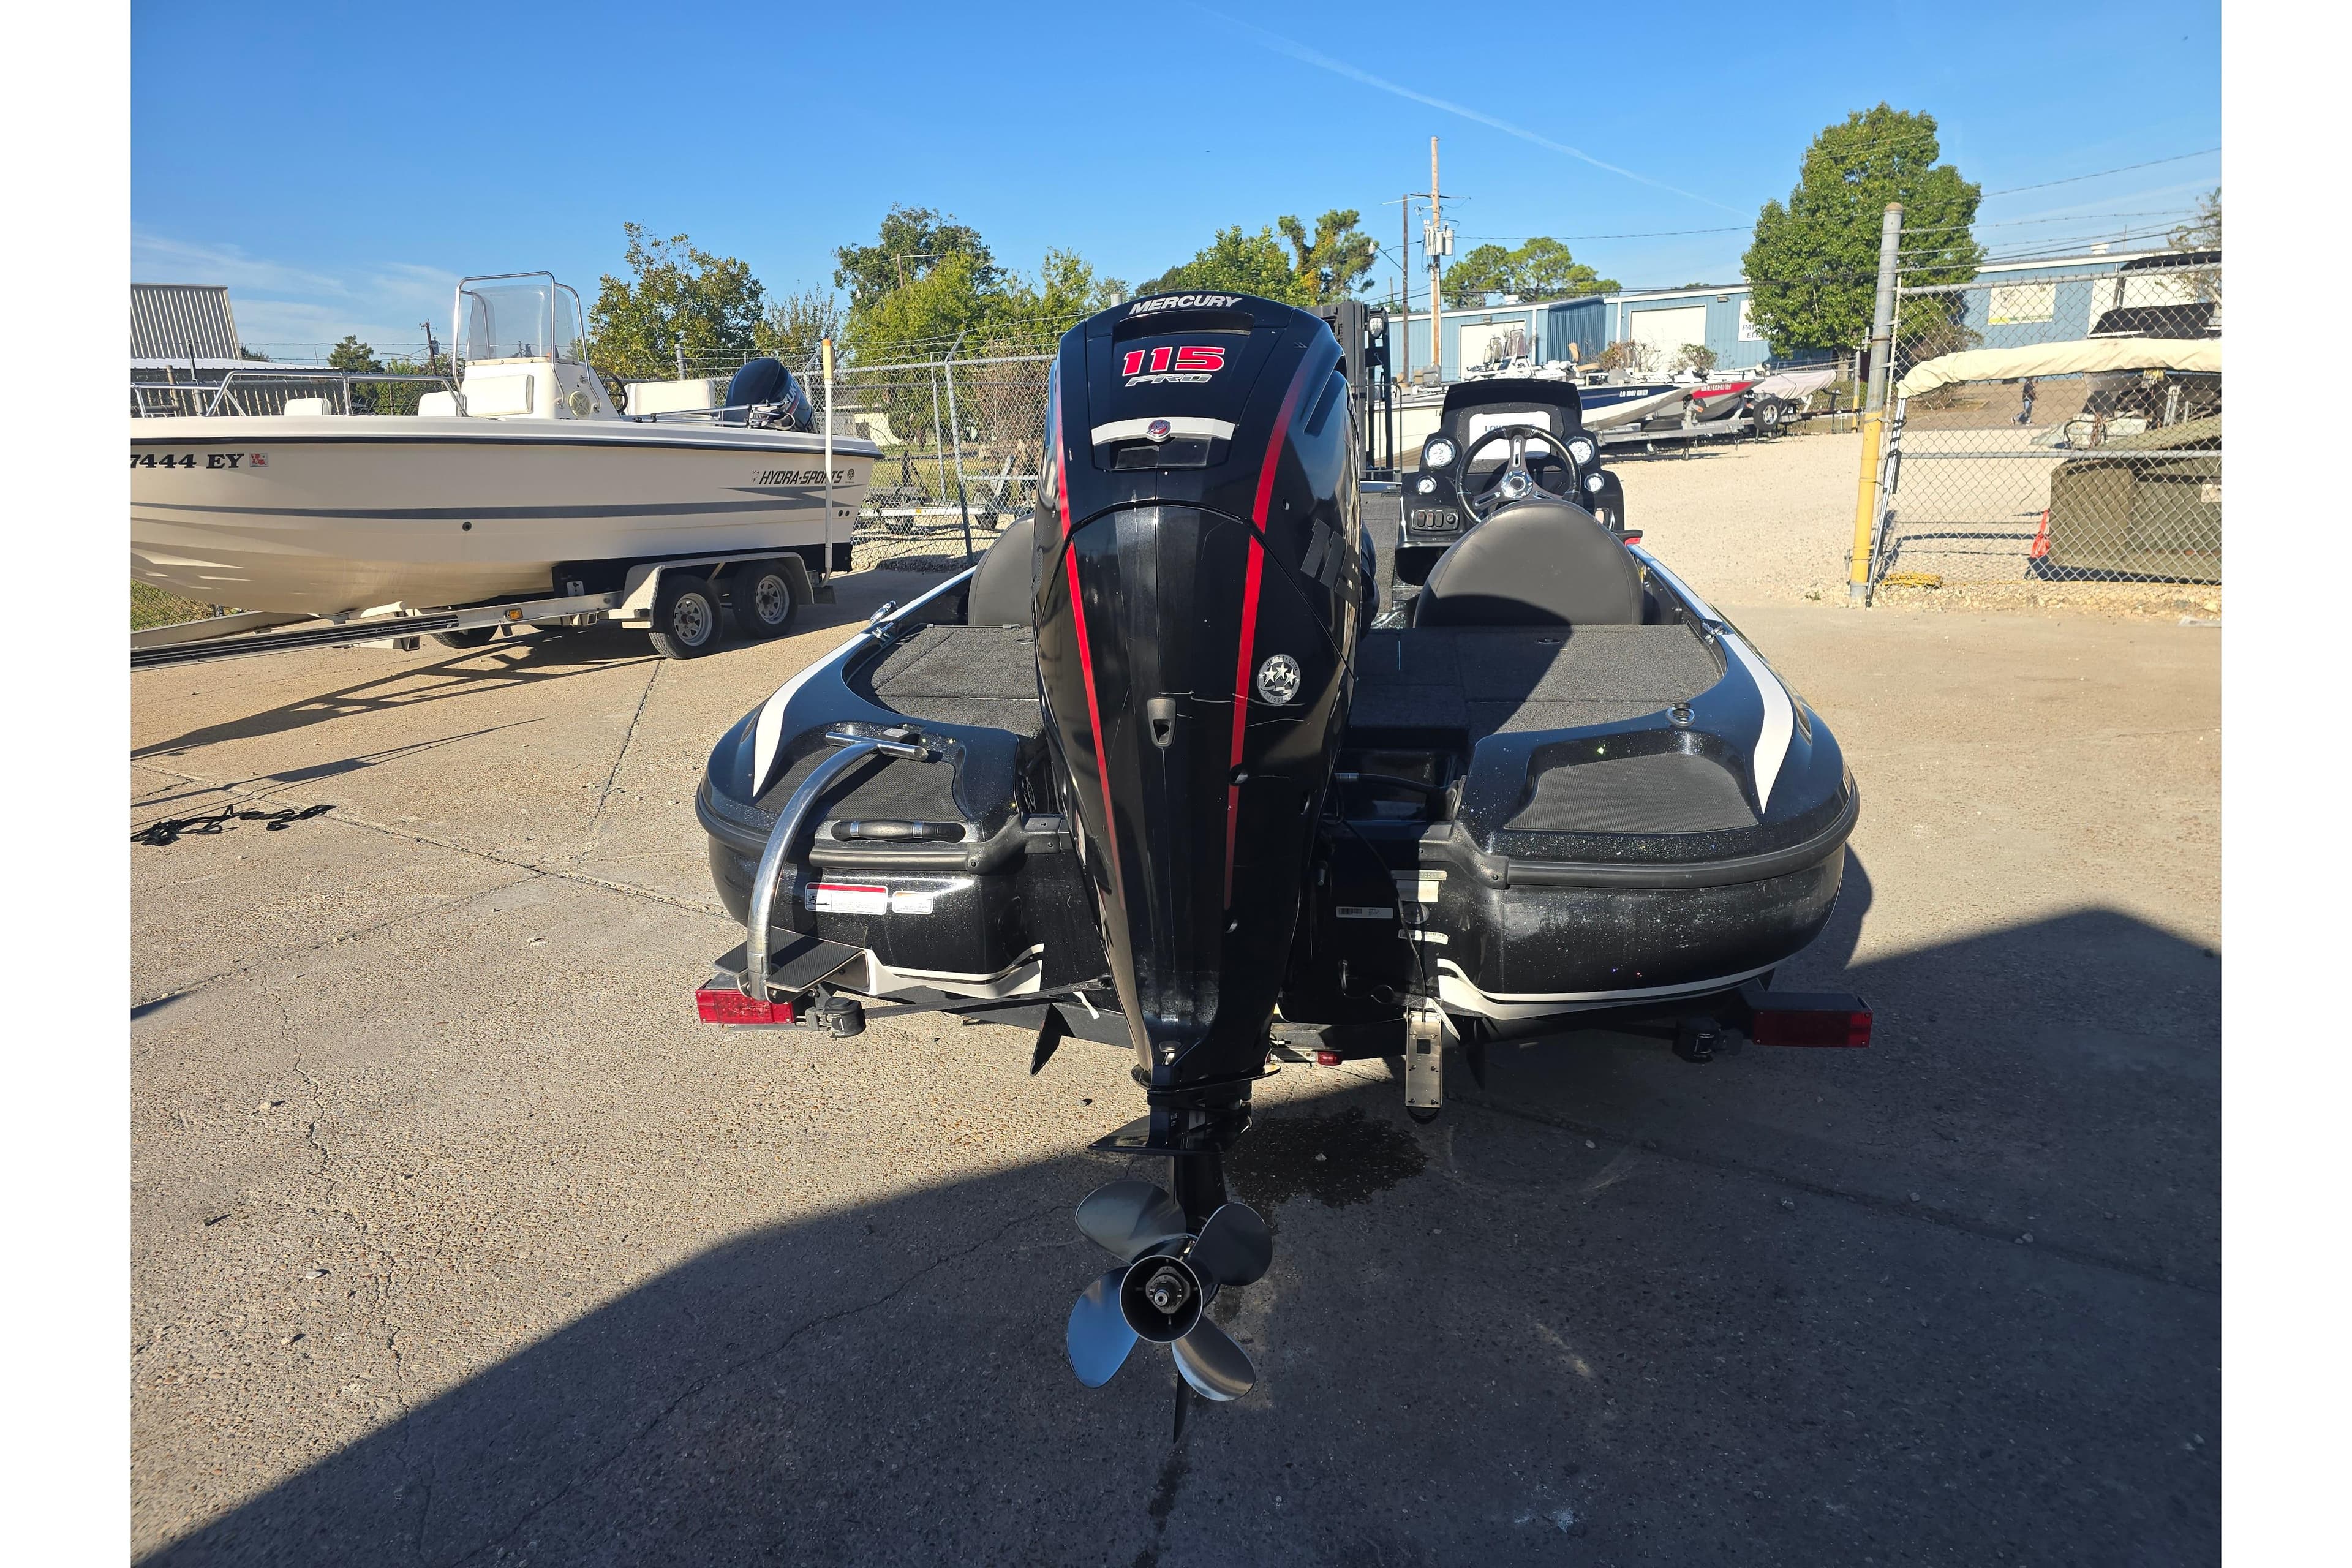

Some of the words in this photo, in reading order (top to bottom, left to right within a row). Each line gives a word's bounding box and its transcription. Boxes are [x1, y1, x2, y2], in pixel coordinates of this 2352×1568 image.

[1129, 295, 1242, 315] MERCURY
[1122, 346, 1226, 377] 115
[1125, 373, 1212, 387] PRO
[130, 454, 197, 469] 7444
[206, 453, 245, 469] EY
